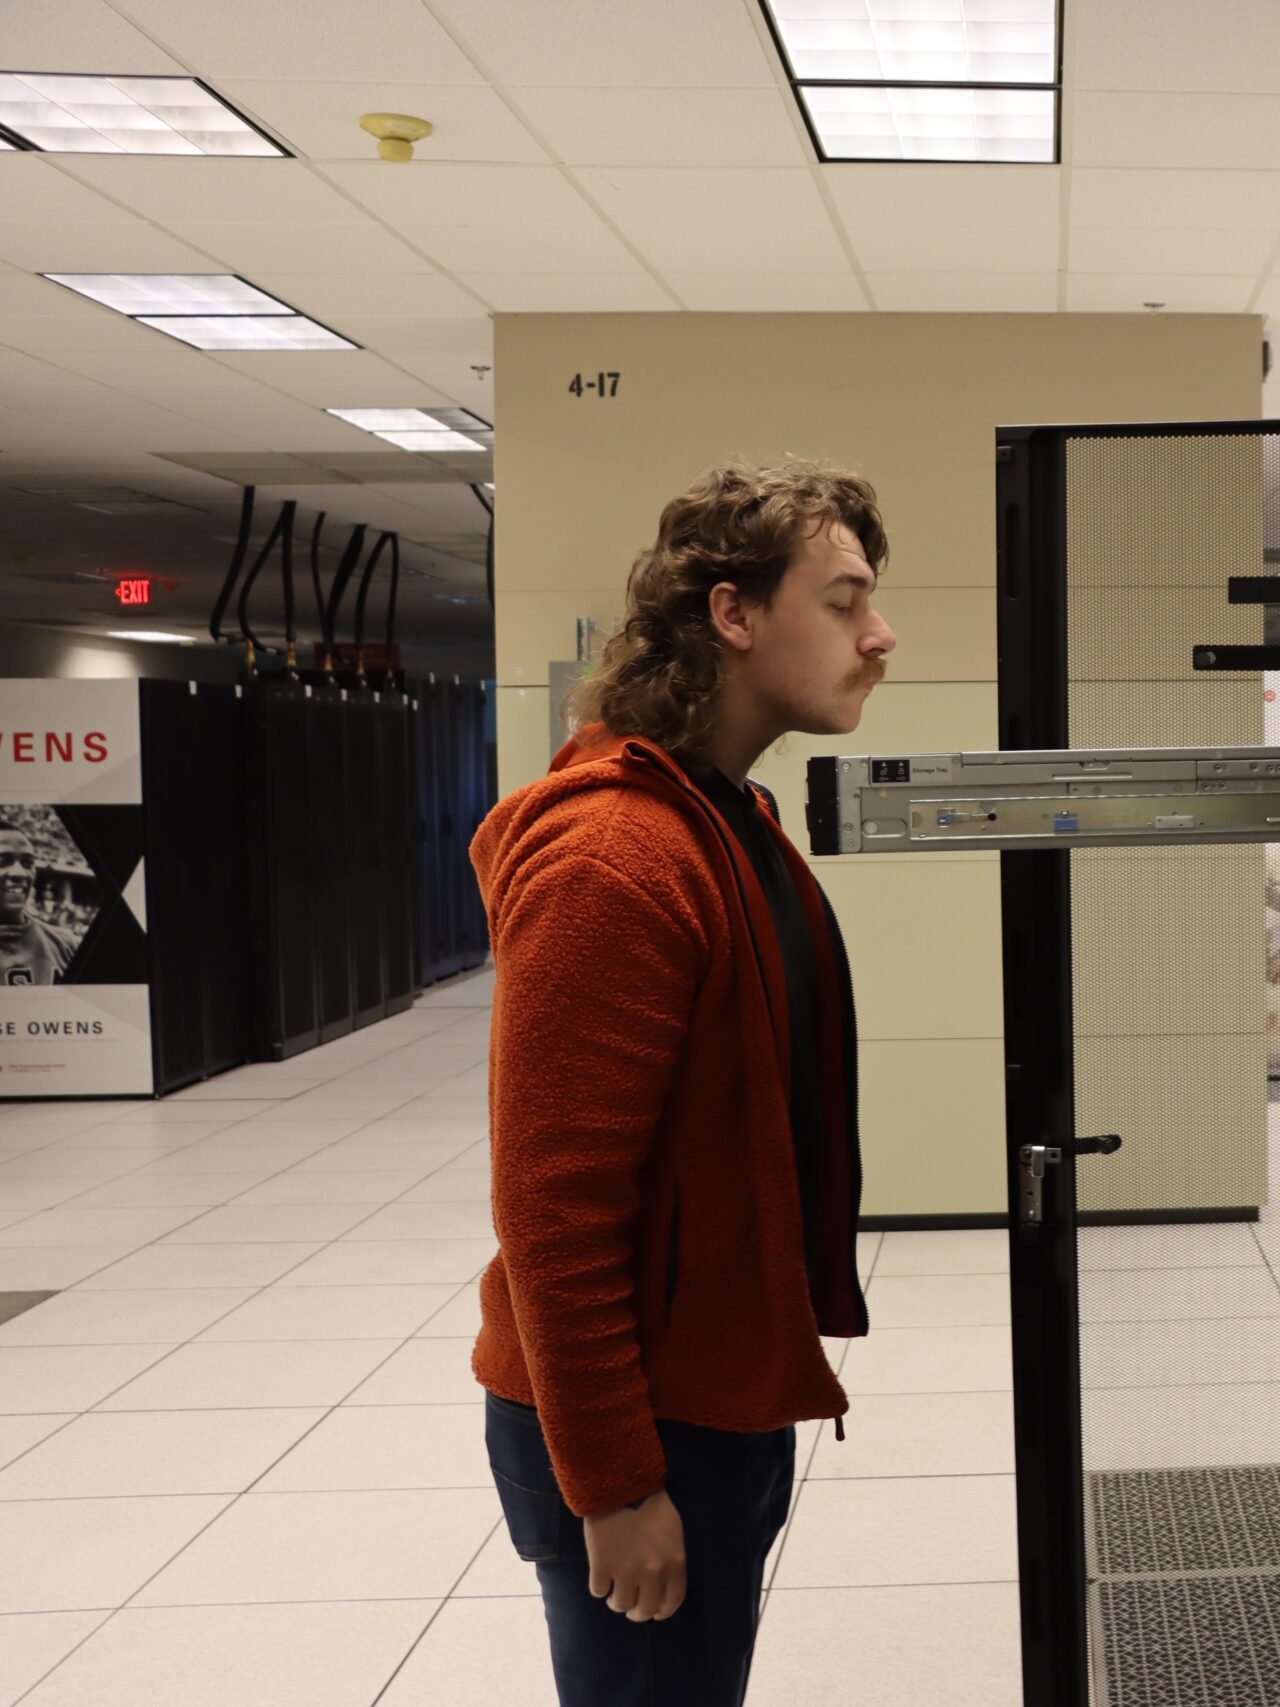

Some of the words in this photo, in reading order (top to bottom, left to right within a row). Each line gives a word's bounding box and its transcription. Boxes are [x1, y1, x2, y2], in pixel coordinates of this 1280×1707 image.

[568, 372, 621, 397] 4-17
[120, 580, 149, 604] EXIT
[0, 731, 108, 763] ENS
[912, 767, 935, 775] Storage
[27, 1021, 103, 1035] OWENS
